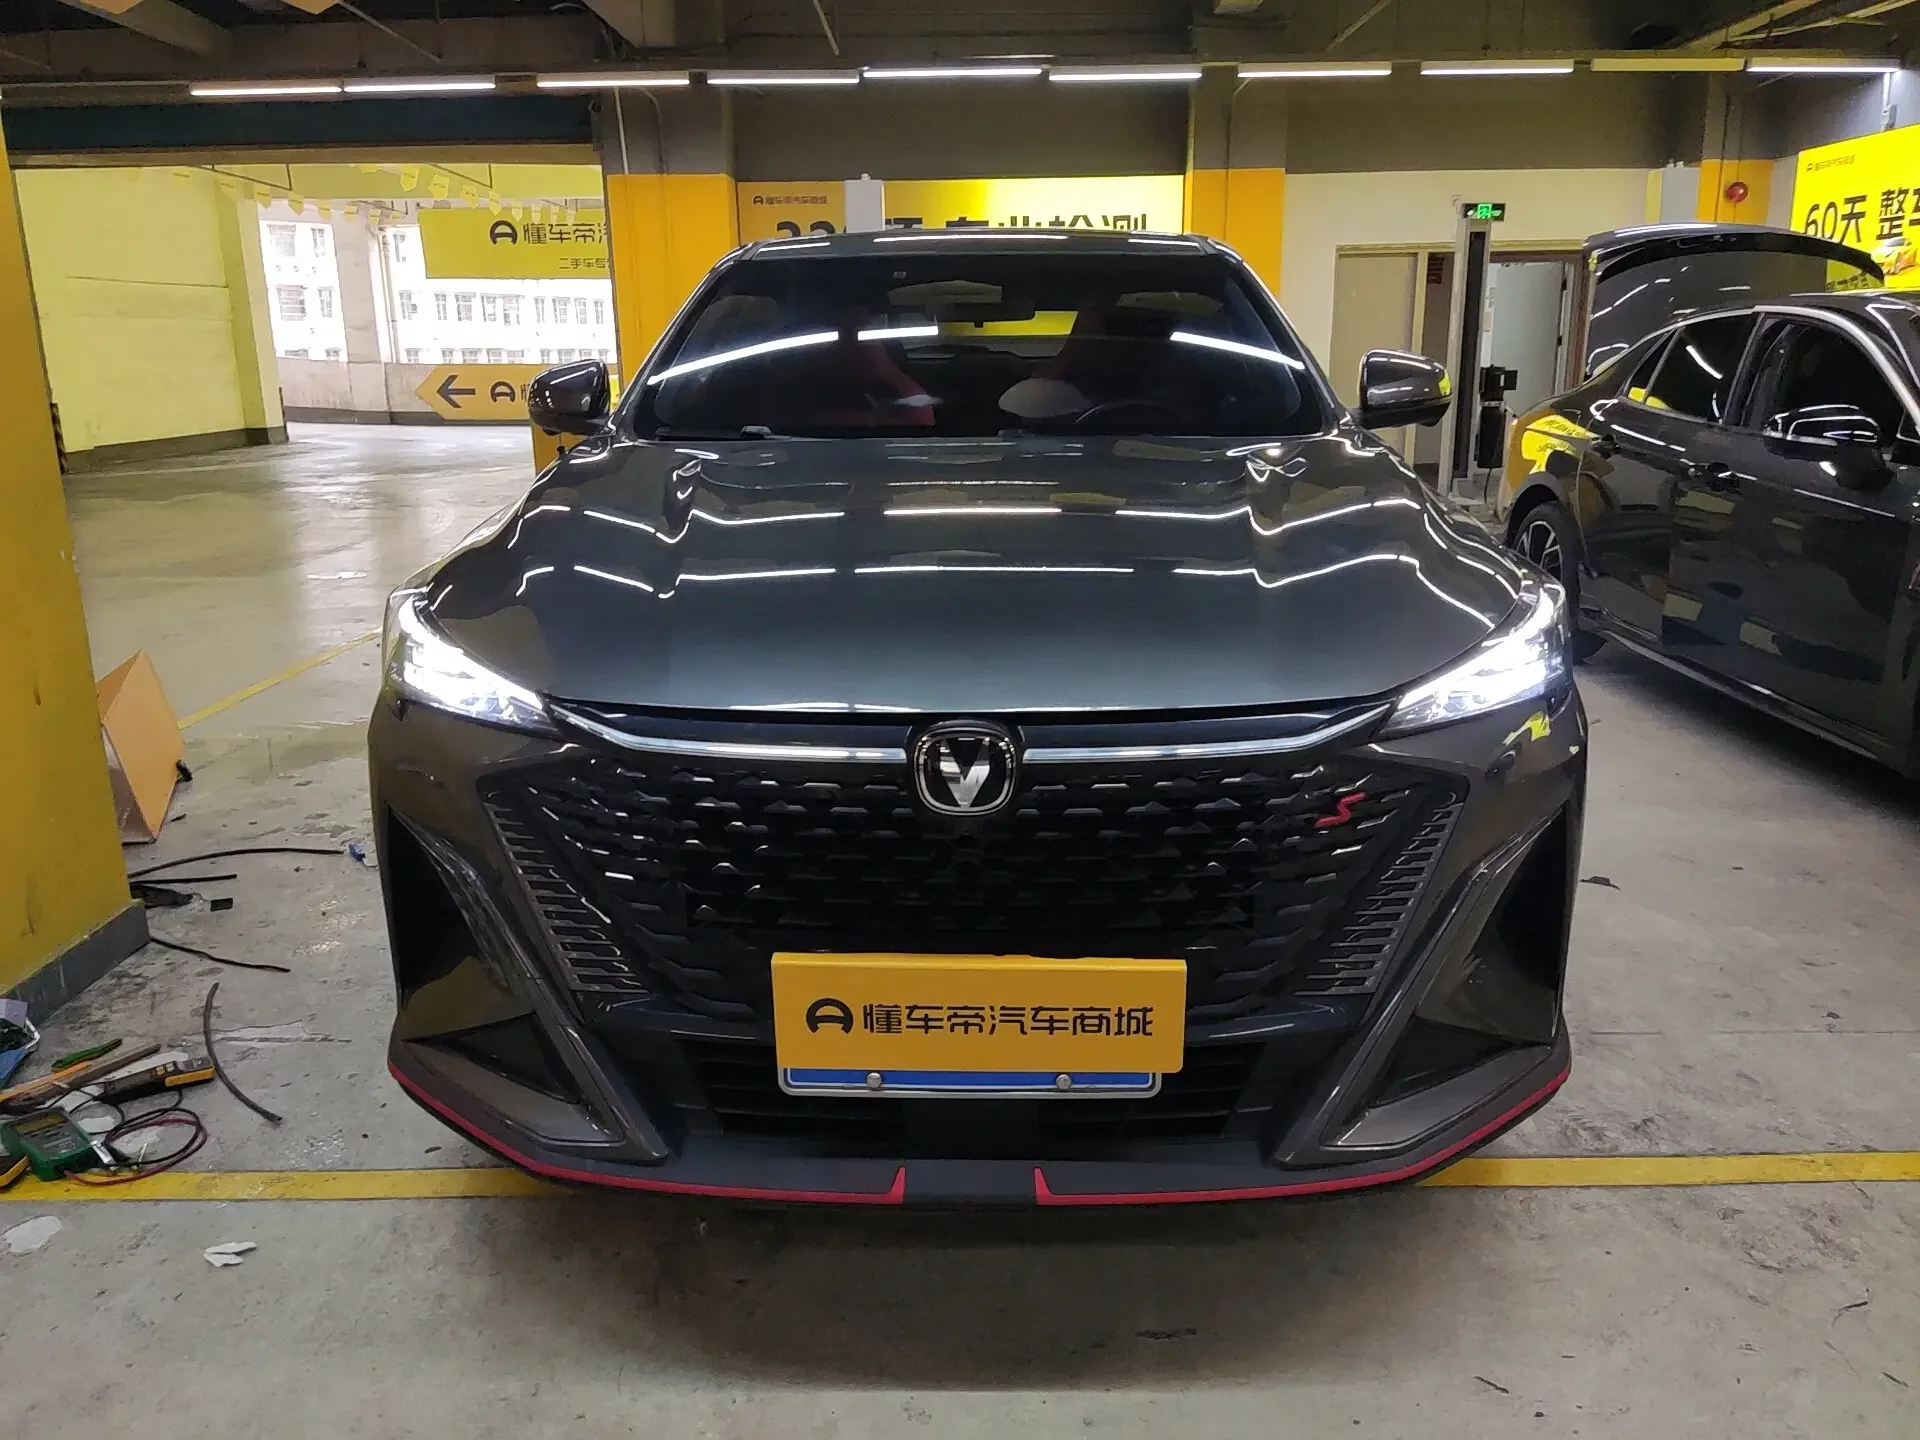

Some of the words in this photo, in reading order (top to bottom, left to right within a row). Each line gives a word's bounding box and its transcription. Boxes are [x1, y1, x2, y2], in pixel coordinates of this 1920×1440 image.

[1805, 195, 1867, 243] 60天
[559, 257, 611, 269] 二手车专
[863, 1003, 1154, 1036] 懂车帝汽车商城
